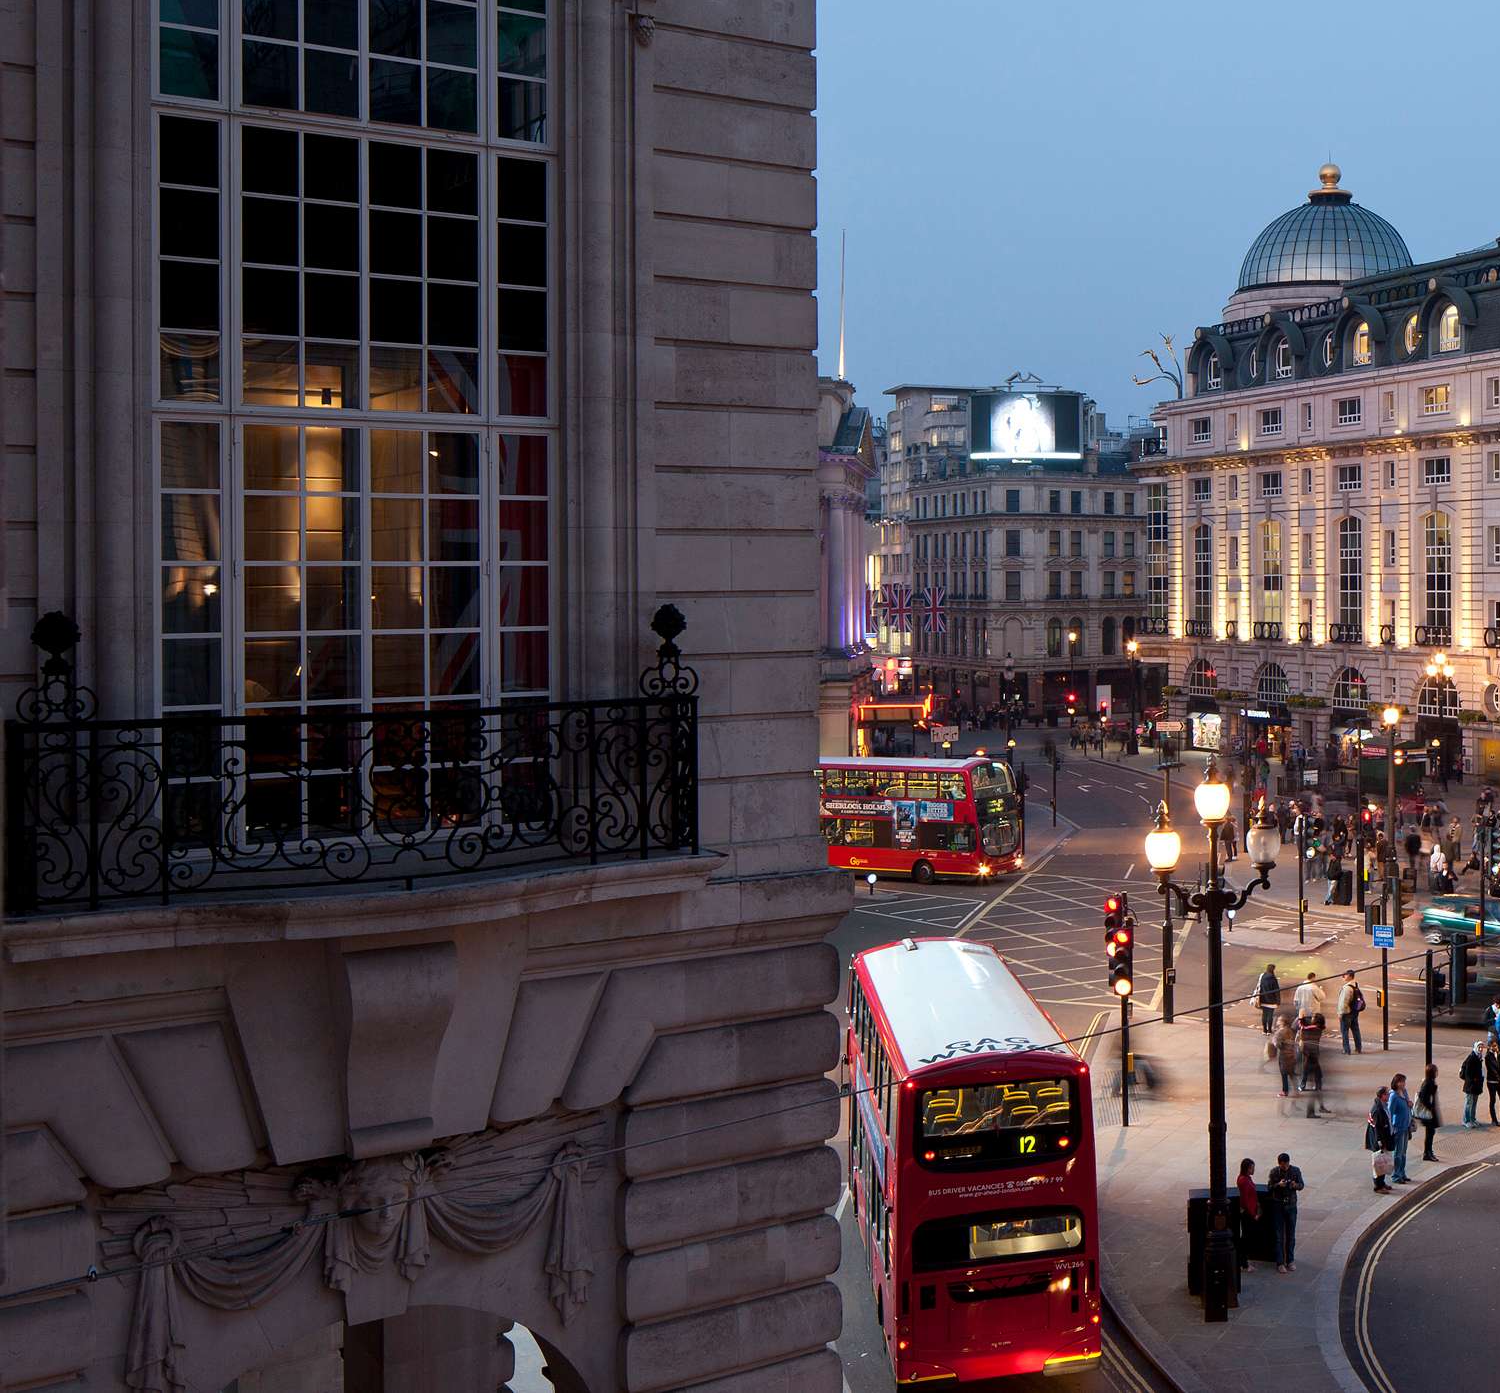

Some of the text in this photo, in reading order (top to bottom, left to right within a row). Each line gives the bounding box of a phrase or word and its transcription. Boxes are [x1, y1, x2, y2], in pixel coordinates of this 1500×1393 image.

[825, 802, 862, 810] SHERLOCK
[945, 1036, 1030, 1050] GAG
[1019, 1135, 1036, 1154] 12
[942, 1184, 966, 1195] DRIVER
[967, 1182, 1005, 1192] VACANCIES
